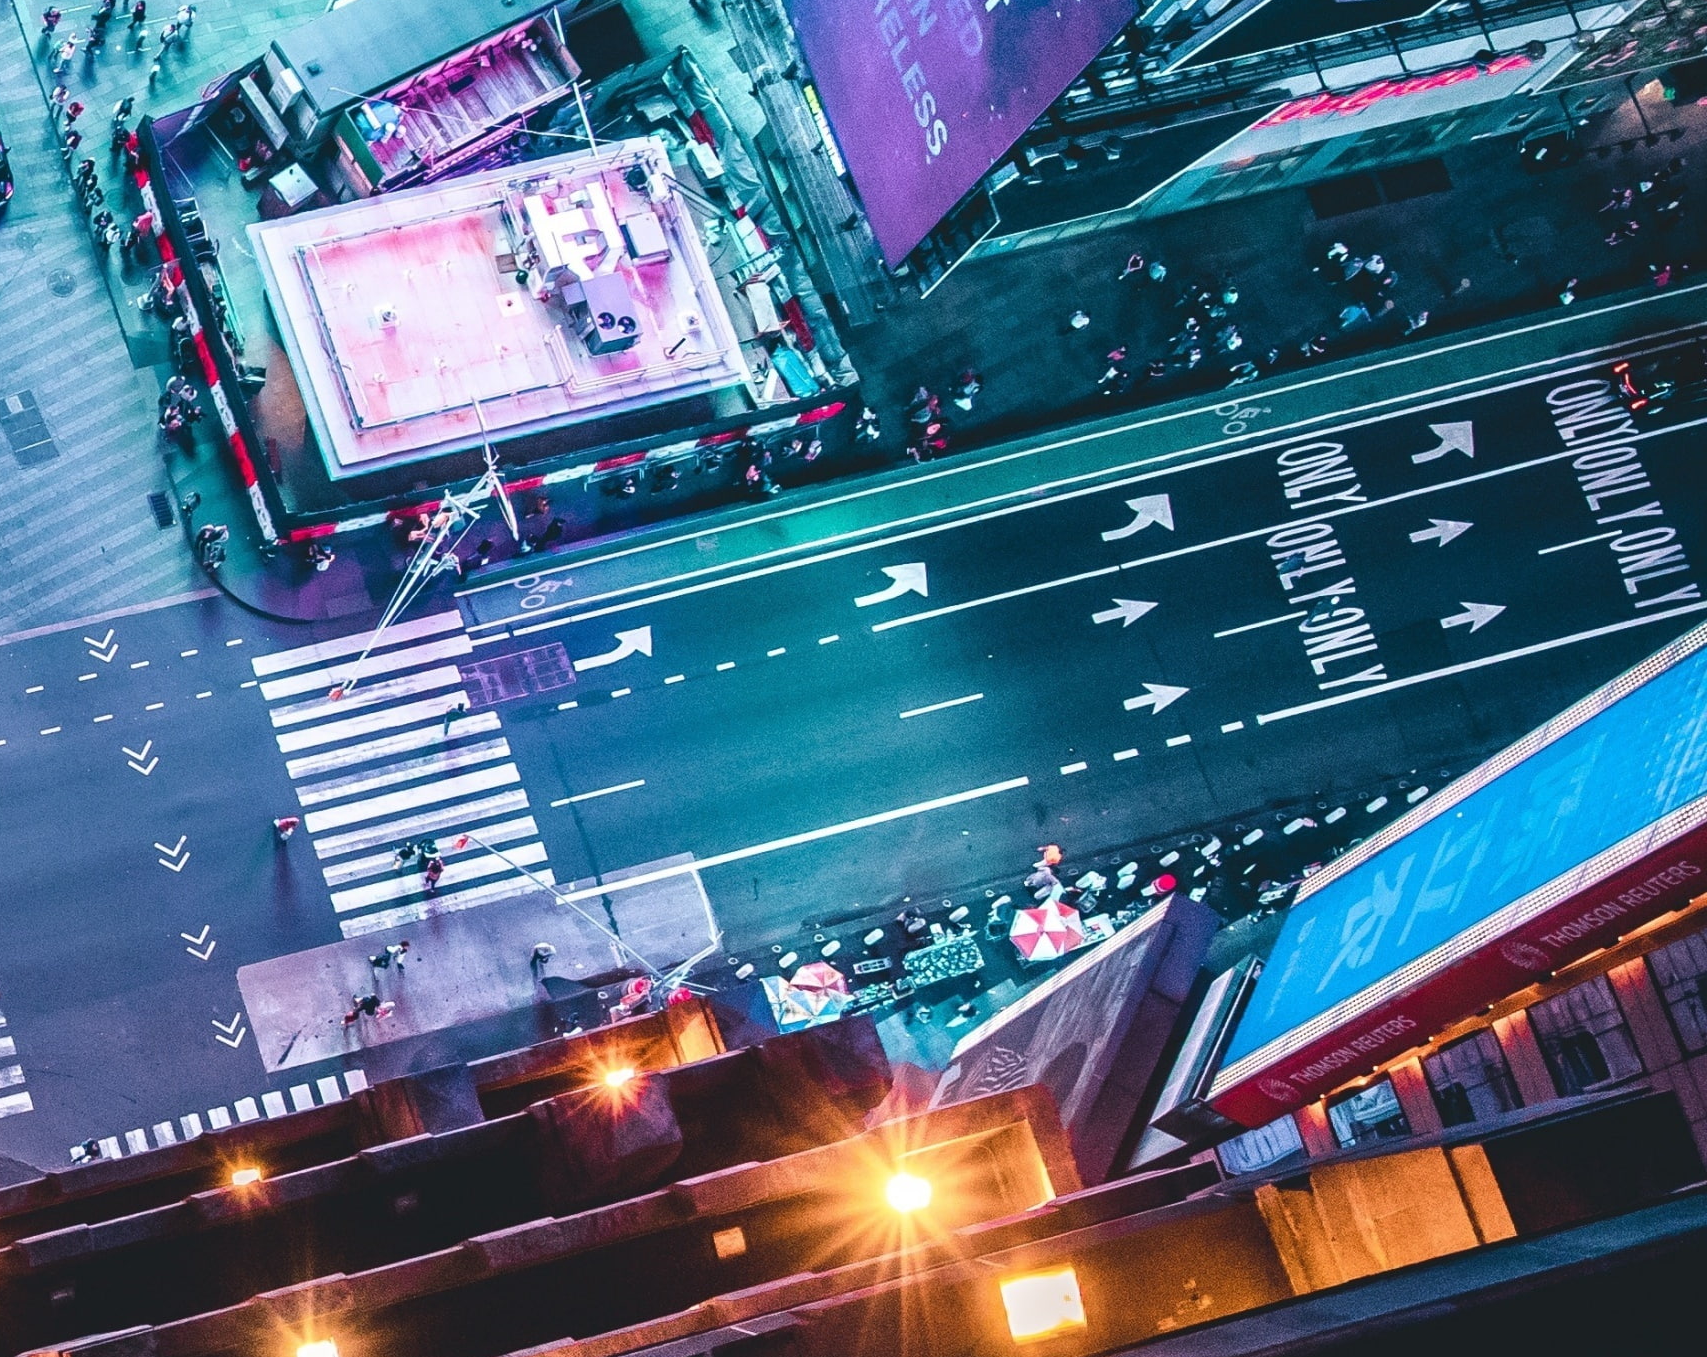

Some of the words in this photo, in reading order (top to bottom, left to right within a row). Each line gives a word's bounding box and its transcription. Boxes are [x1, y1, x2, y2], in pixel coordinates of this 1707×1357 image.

[1547, 378, 1639, 449] ONLY
[1278, 442, 1367, 510] ONLY
[1572, 445, 1664, 528] ONLY
[1265, 522, 1357, 605] ONLY
[1609, 527, 1702, 611] ONLY
[1540, 901, 1626, 948] THOMSON
[1621, 860, 1703, 917] REUTERS
[1289, 1047, 1360, 1085] THOMSON
[1356, 1015, 1419, 1058] REUTERS
